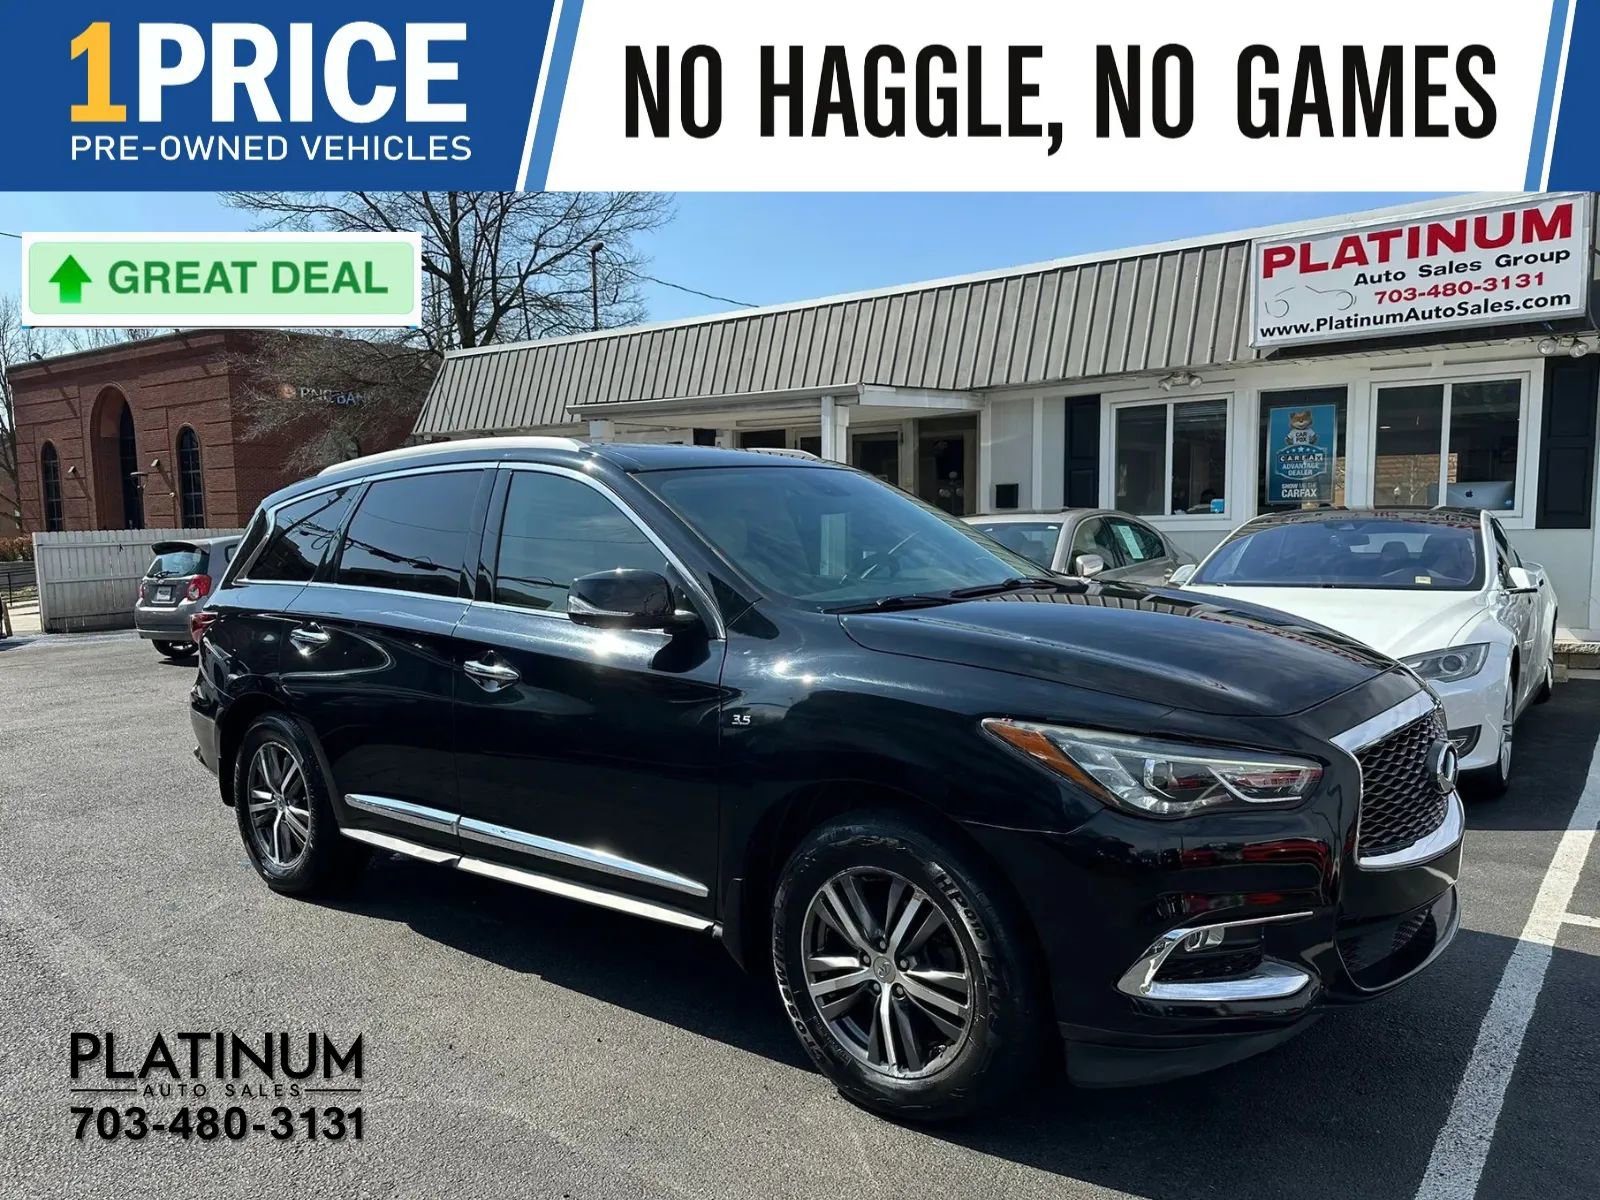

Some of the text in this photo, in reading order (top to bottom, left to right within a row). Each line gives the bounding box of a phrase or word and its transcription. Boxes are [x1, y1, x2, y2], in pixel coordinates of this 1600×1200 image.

[1263, 203, 1574, 279] PLATINUM
[1353, 249, 1571, 287] Auto Sales Group
[1374, 271, 1544, 305] 703-480-3131
[1260, 293, 1572, 338] www.PlatinumAutoSales.com
[1281, 488, 1317, 498] CARFAX
